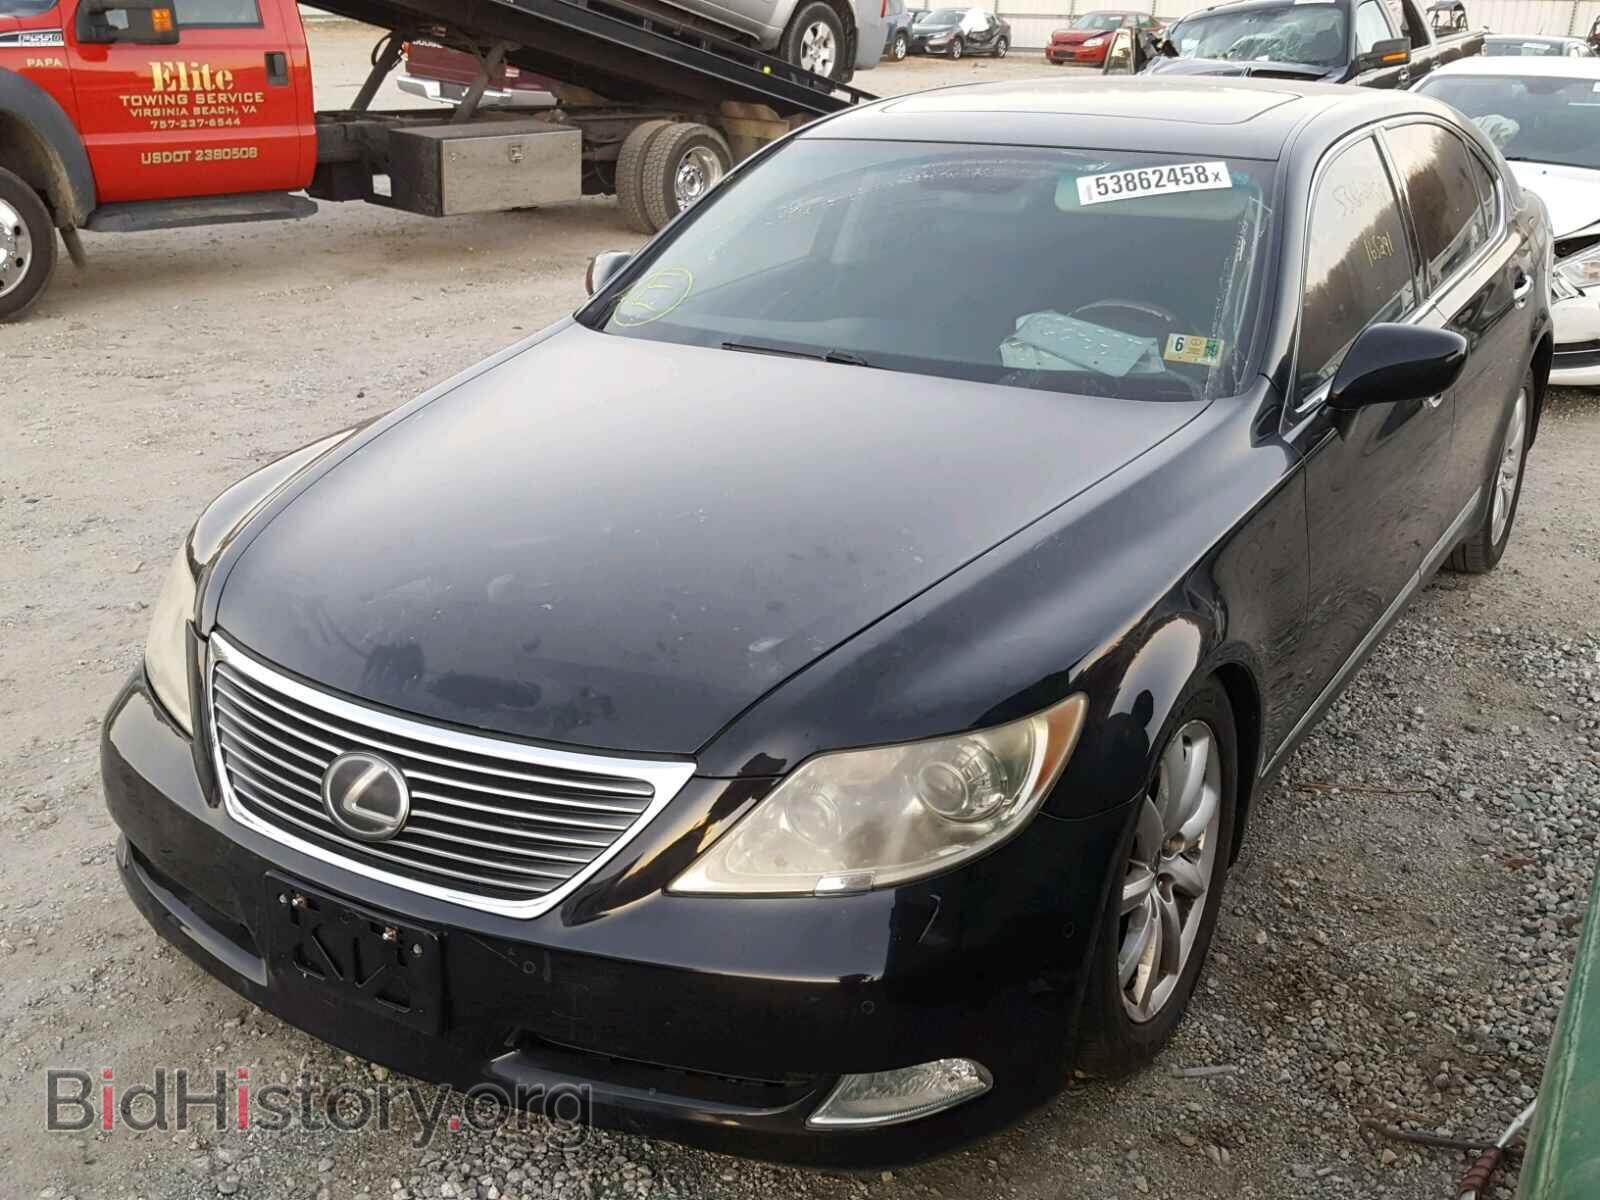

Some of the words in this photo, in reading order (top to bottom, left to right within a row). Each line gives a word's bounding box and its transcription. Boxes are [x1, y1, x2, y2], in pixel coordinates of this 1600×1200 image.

[26, 58, 64, 68] PAPA
[148, 61, 234, 92] Elite
[119, 93, 188, 107] TOWING
[195, 91, 265, 105] SERVICE
[129, 107, 189, 118] VIRGINIA
[192, 105, 239, 116] BEACH,
[242, 104, 257, 113] VA
[140, 150, 192, 165] USDOT
[1095, 164, 1210, 197] 53862458
[1174, 336, 1185, 352] 6
